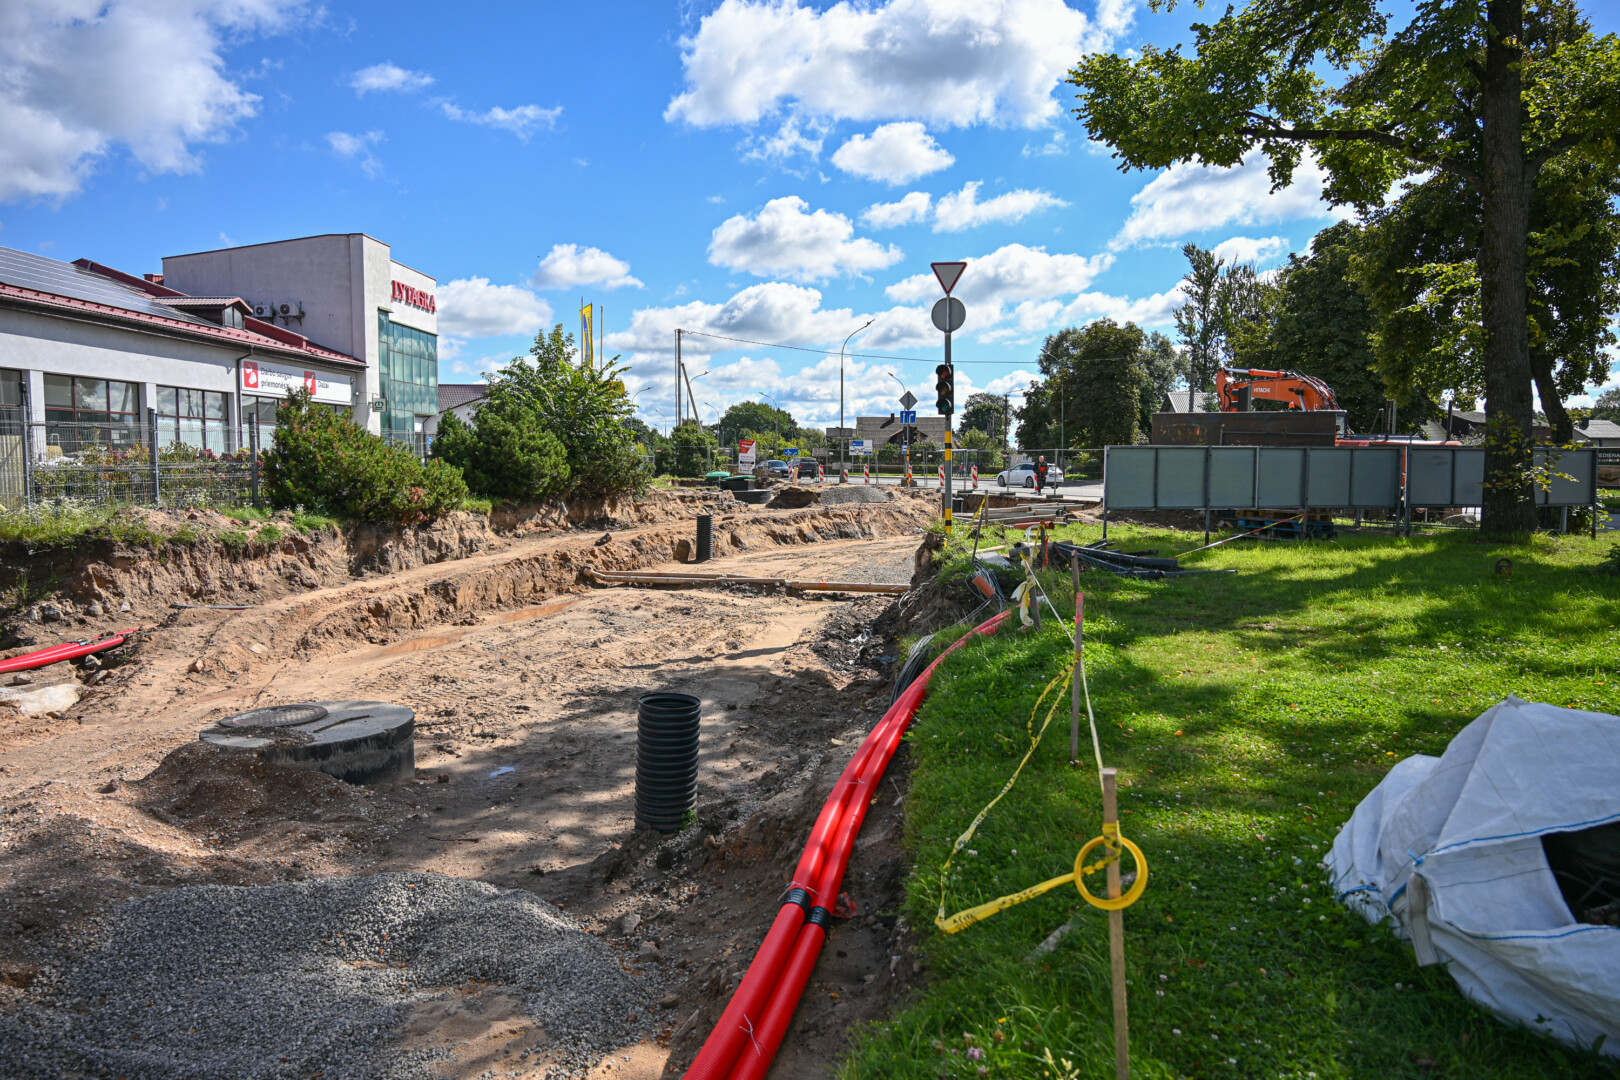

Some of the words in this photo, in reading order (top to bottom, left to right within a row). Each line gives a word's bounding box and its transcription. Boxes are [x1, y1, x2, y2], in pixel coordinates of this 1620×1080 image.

[391, 280, 437, 312] LYTAGRA
[260, 368, 276, 377] Darbo
[277, 371, 292, 381] saugos
